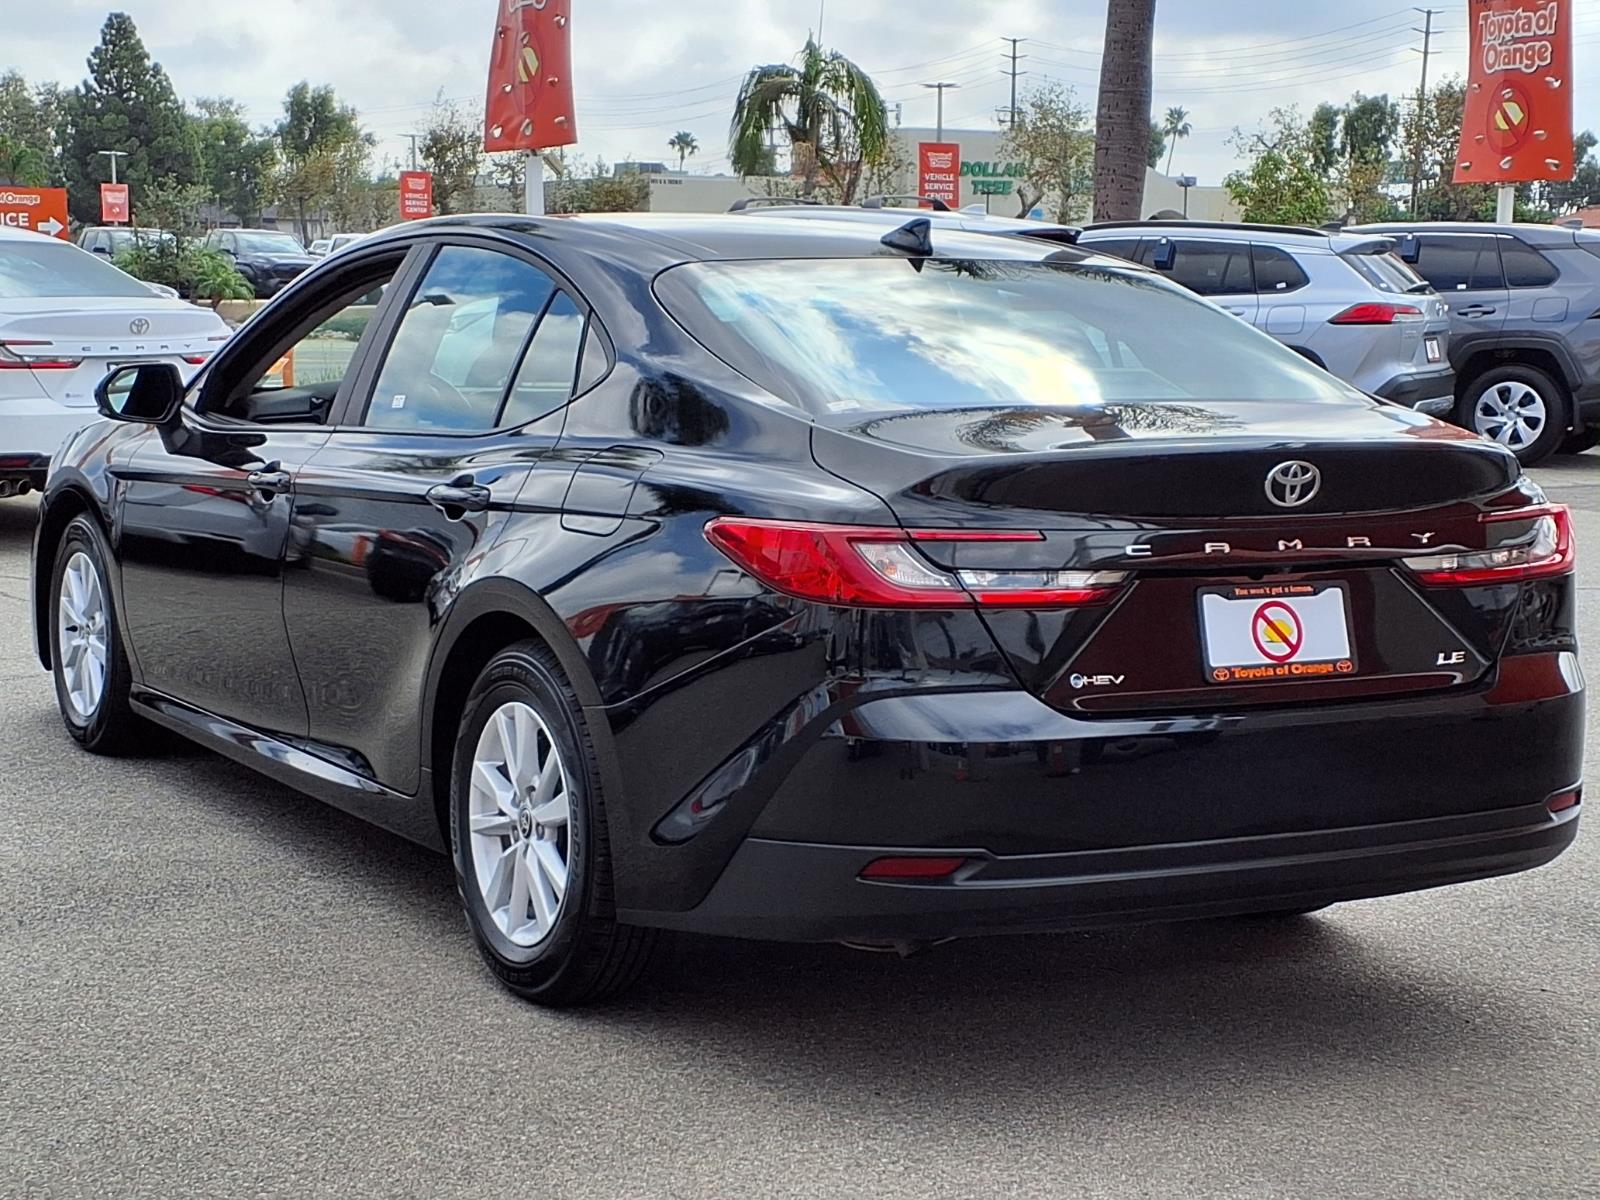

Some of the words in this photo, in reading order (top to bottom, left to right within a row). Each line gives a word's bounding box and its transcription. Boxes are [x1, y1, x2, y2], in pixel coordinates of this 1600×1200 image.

[1479, 8, 1535, 46] Toyota
[1535, 2, 1557, 35] of
[1483, 41, 1551, 73] Orange
[959, 161, 1024, 177] DOLLAR
[925, 173, 954, 181] VEHICLE
[971, 181, 1013, 195] TREE
[925, 192, 954, 200] CENTER
[1125, 531, 1435, 555] CAMRY
[1436, 651, 1466, 665] LE
[1231, 667, 1274, 680] Toyota
[1275, 664, 1289, 676] of
[1291, 663, 1334, 676] Orange
[1082, 675, 1125, 686] HEV
